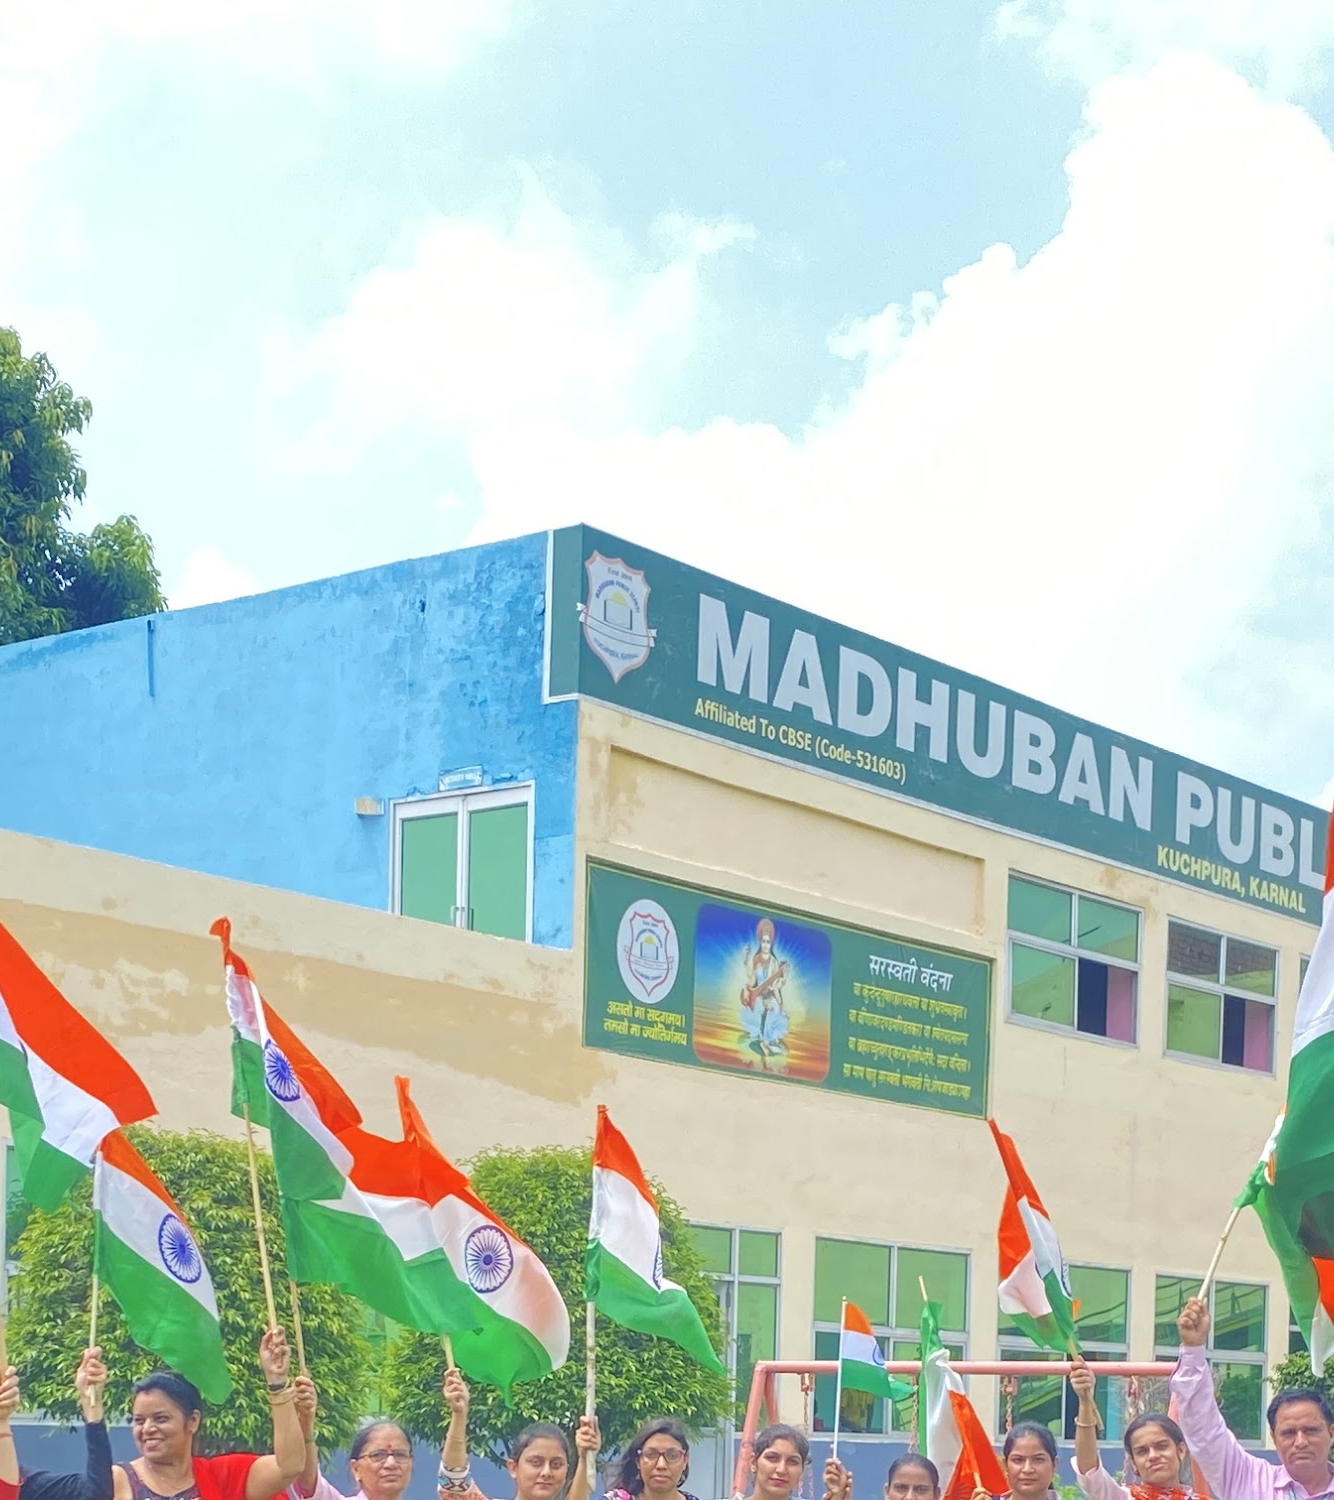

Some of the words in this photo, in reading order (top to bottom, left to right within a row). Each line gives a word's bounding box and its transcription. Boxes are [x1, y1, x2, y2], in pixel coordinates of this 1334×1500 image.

[695, 698, 756, 734] Affiliated
[760, 718, 775, 740] To
[779, 726, 812, 752] CBSE
[815, 736, 906, 785] (Code-531603)
[697, 593, 1153, 831] MADHUBAN
[1175, 770, 1326, 891] PUBL
[1157, 845, 1245, 898] KUCHPURA,
[1249, 876, 1306, 914] KARNAL
[869, 955, 918, 984] सरस्वती
[921, 963, 953, 992] वंदना
[603, 1016, 629, 1035] तमसो
[630, 1024, 641, 1038] मा
[607, 1000, 633, 1018] असतो
[634, 1006, 645, 1022] मा
